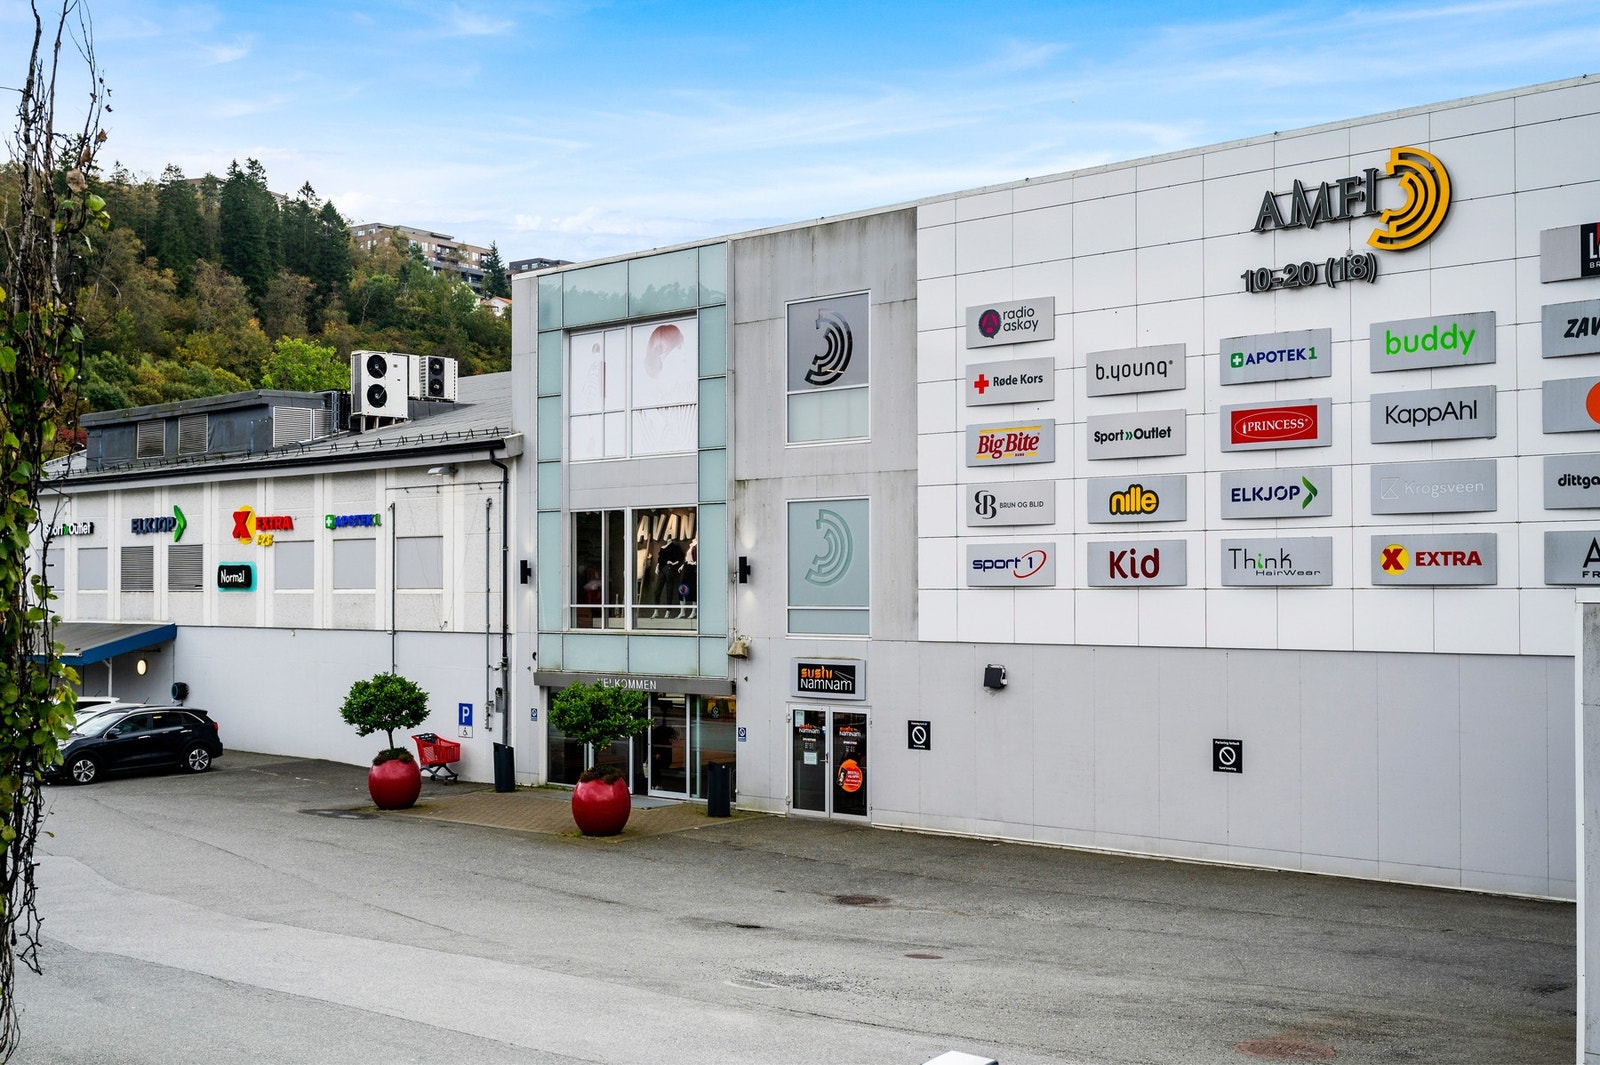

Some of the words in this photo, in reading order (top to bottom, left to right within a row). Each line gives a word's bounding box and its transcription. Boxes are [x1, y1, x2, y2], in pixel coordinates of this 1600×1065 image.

[1251, 168, 1379, 232] AMFI
[1241, 261, 1317, 293] 10-20
[1325, 252, 1377, 288] (18)
[1003, 306, 1035, 320] radio
[1003, 318, 1039, 332] askøy
[1385, 323, 1475, 355] buddy
[993, 377, 1019, 387] Røde
[1020, 373, 1043, 384] Kors
[1385, 400, 1477, 427] KappAhl
[1247, 418, 1305, 432] PRINCESS
[1404, 480, 1484, 499] Krogsveen
[1000, 501, 1016, 509] BRUN
[1029, 500, 1044, 508] BLID
[1110, 484, 1159, 515] nille
[256, 515, 294, 531] EXTRA
[972, 558, 1021, 572] sport
[1027, 557, 1033, 568] 1
[1109, 547, 1159, 579] Kid
[1228, 548, 1292, 570] Think
[1415, 551, 1482, 567] EXTRA
[220, 570, 245, 584] Normal
[1255, 569, 1321, 577] HairWear
[801, 666, 833, 679] sushi
[801, 678, 852, 691] NamNam
[462, 706, 470, 723] P
